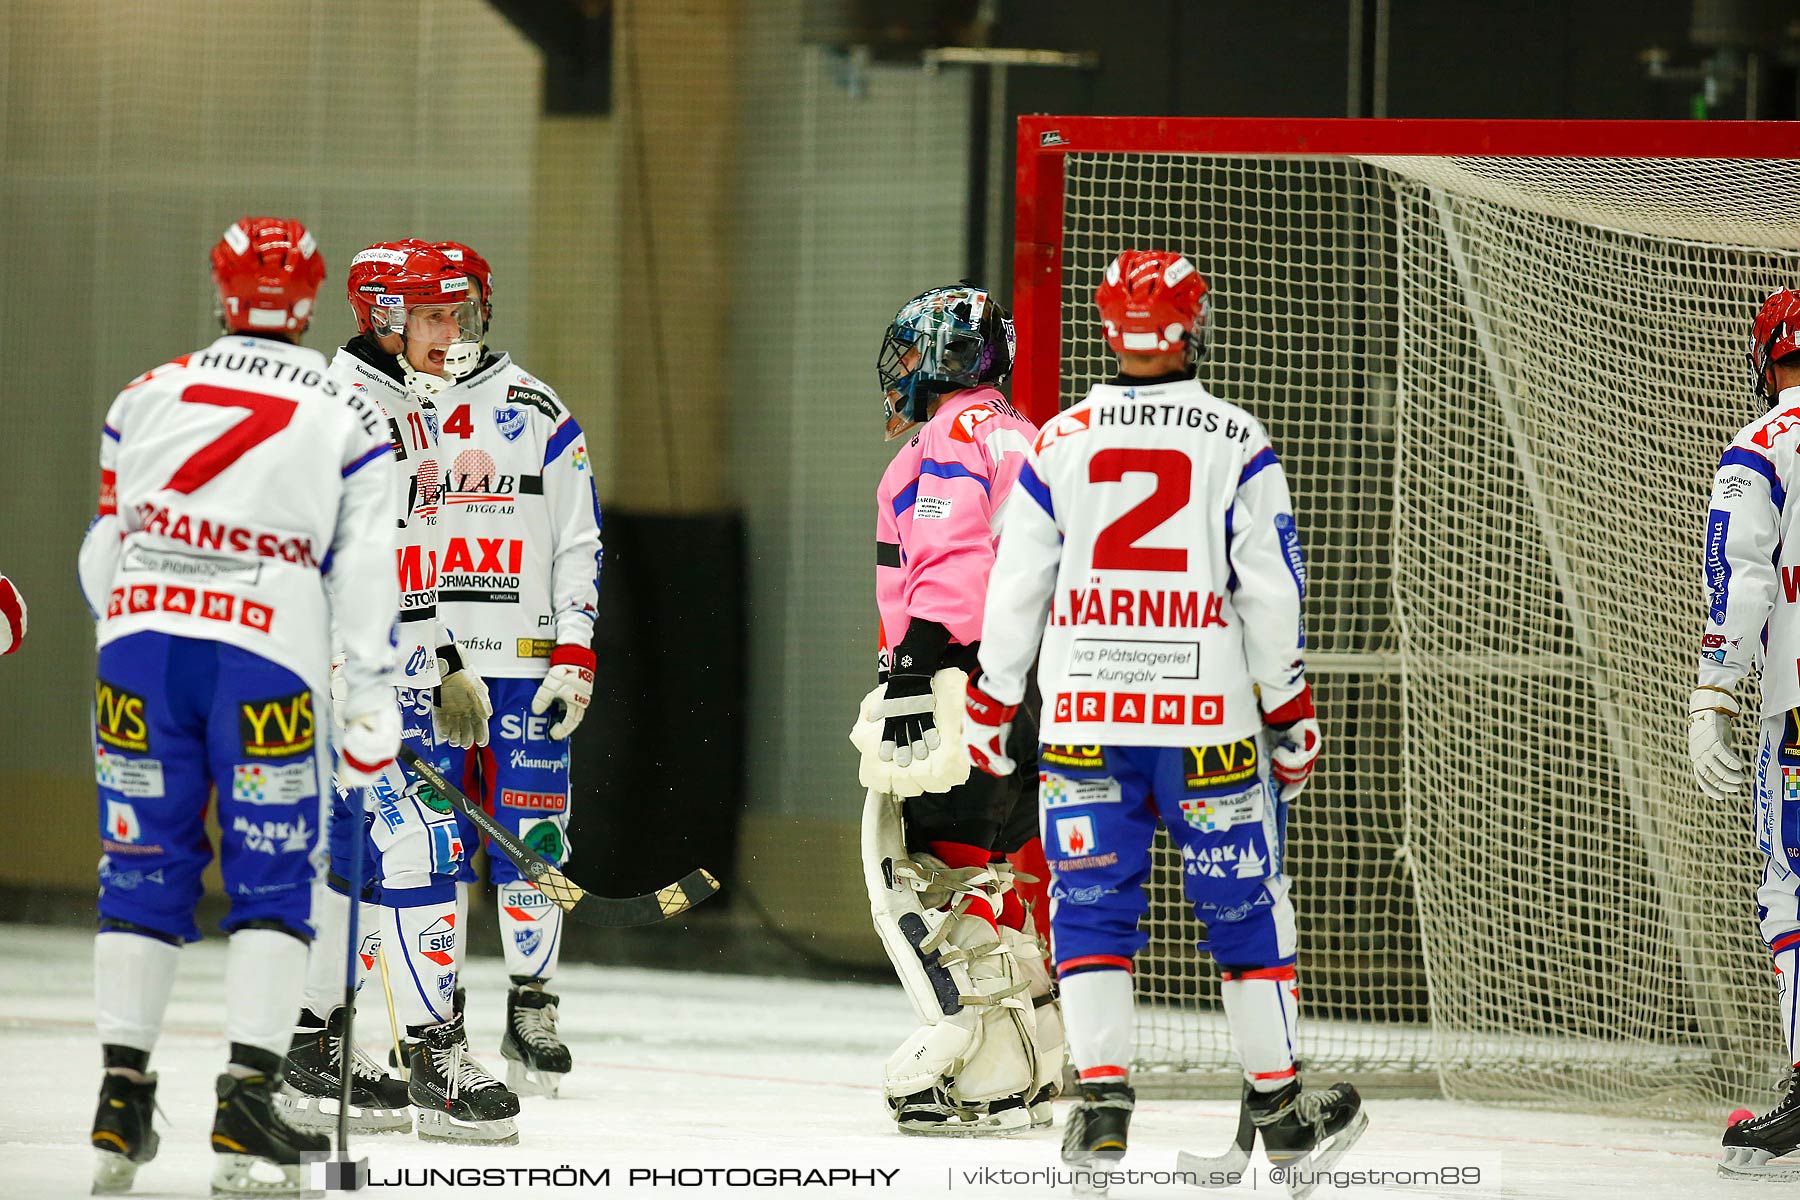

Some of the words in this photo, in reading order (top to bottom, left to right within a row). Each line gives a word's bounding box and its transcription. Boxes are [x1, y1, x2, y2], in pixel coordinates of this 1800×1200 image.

[200, 351, 339, 397] HURTIGS
[406, 411, 429, 451] 11
[442, 403, 474, 440] 4
[496, 411, 511, 421] IFK
[1099, 404, 1219, 433] HURTIGS
[160, 384, 300, 495] 7
[465, 503, 497, 515] BYGG
[498, 505, 515, 515] AB
[1088, 447, 1192, 572] 2
[1096, 666, 1157, 683] Kungälv
[1098, 648, 1192, 666] Plåtslageriet
[242, 690, 316, 746] YVS
[1054, 691, 1225, 725] CRAMO
[1189, 738, 1257, 777] YVS
[1182, 842, 1238, 863] MARK
